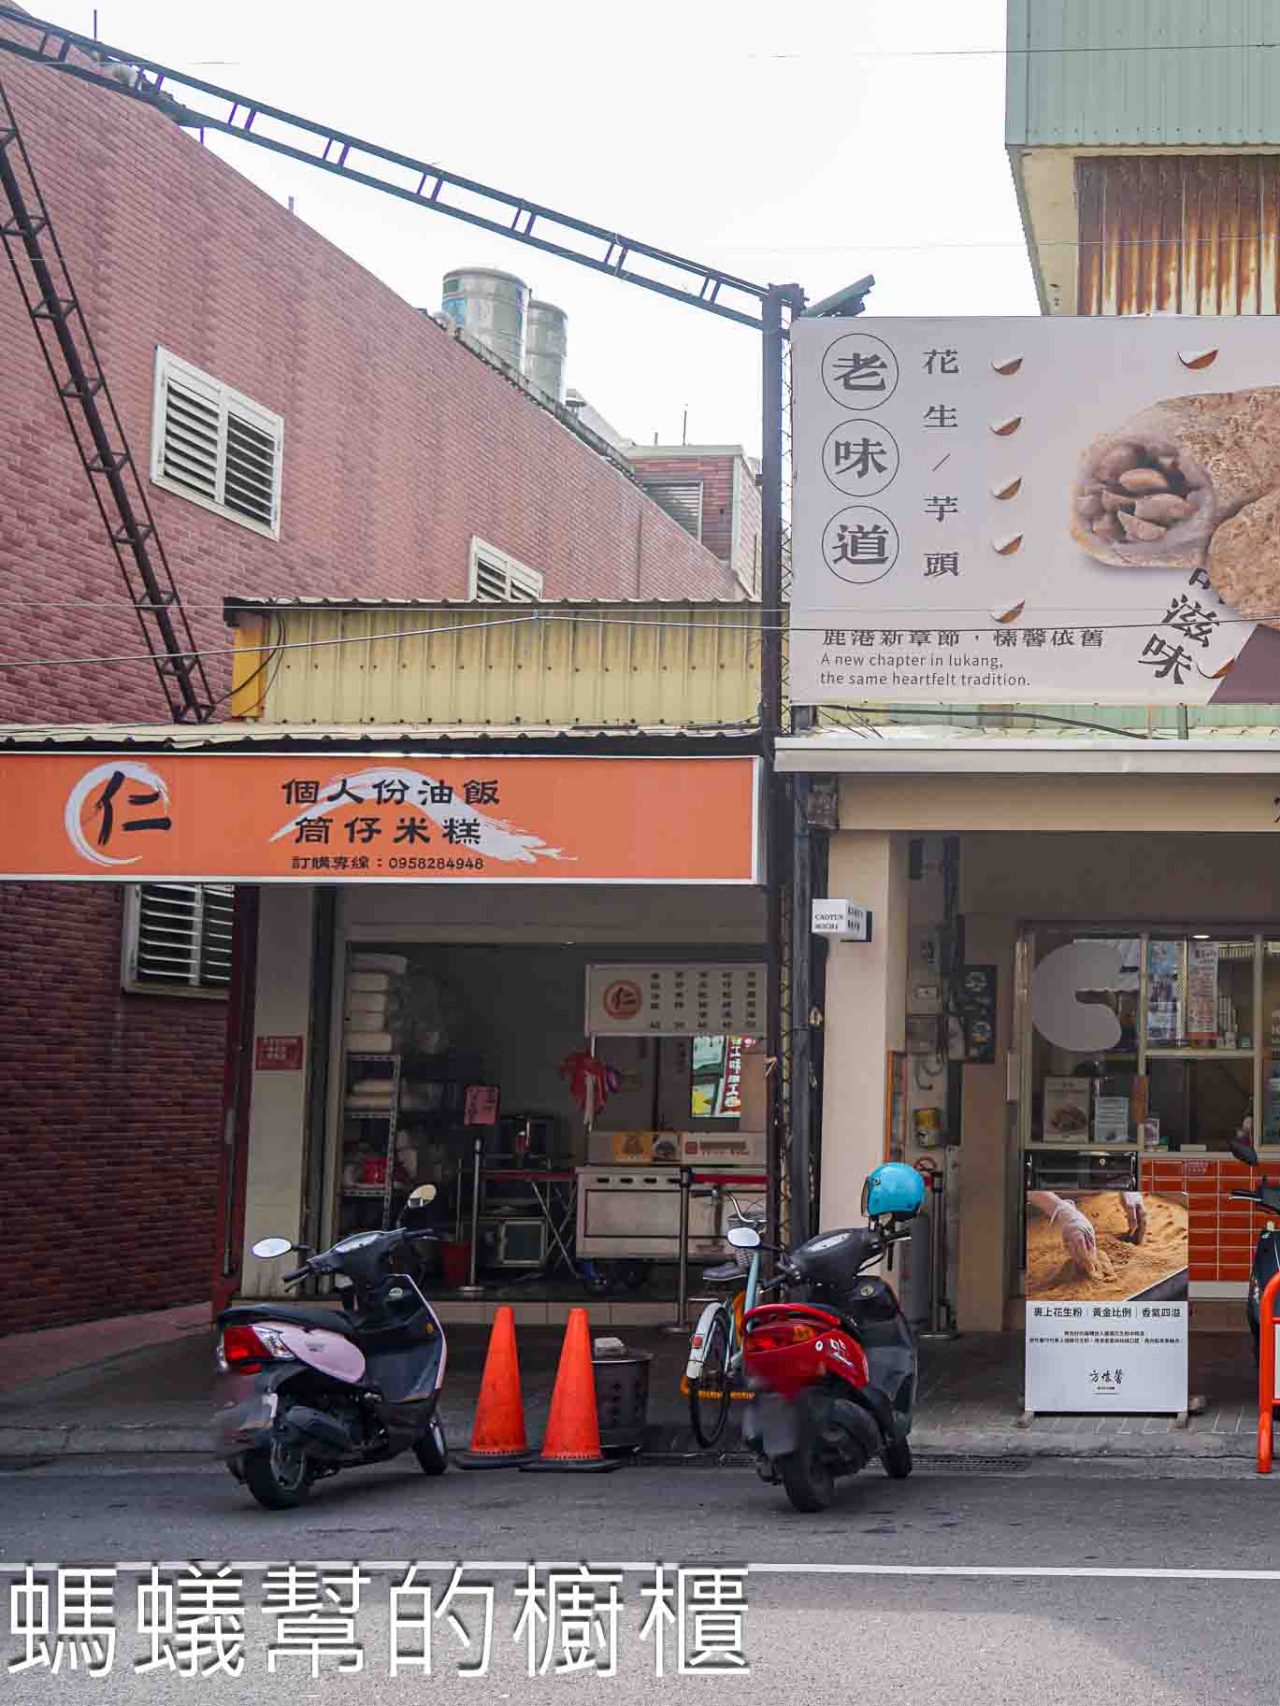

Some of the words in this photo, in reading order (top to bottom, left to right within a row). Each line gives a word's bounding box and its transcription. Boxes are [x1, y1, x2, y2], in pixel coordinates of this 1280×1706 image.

[832, 353, 889, 565] 老味道
[821, 653, 831, 666] A
[835, 655, 864, 666] new
[869, 653, 925, 669] chapter
[931, 653, 943, 666] in
[950, 653, 1003, 669] lukang,
[821, 672, 844, 684] the
[850, 675, 887, 685] same
[893, 673, 956, 686] heartfelt
[961, 673, 1030, 686] tradition.
[281, 779, 501, 805] 個人份油飯
[94, 771, 172, 847] 仁
[294, 816, 481, 844] 筒仔米糕
